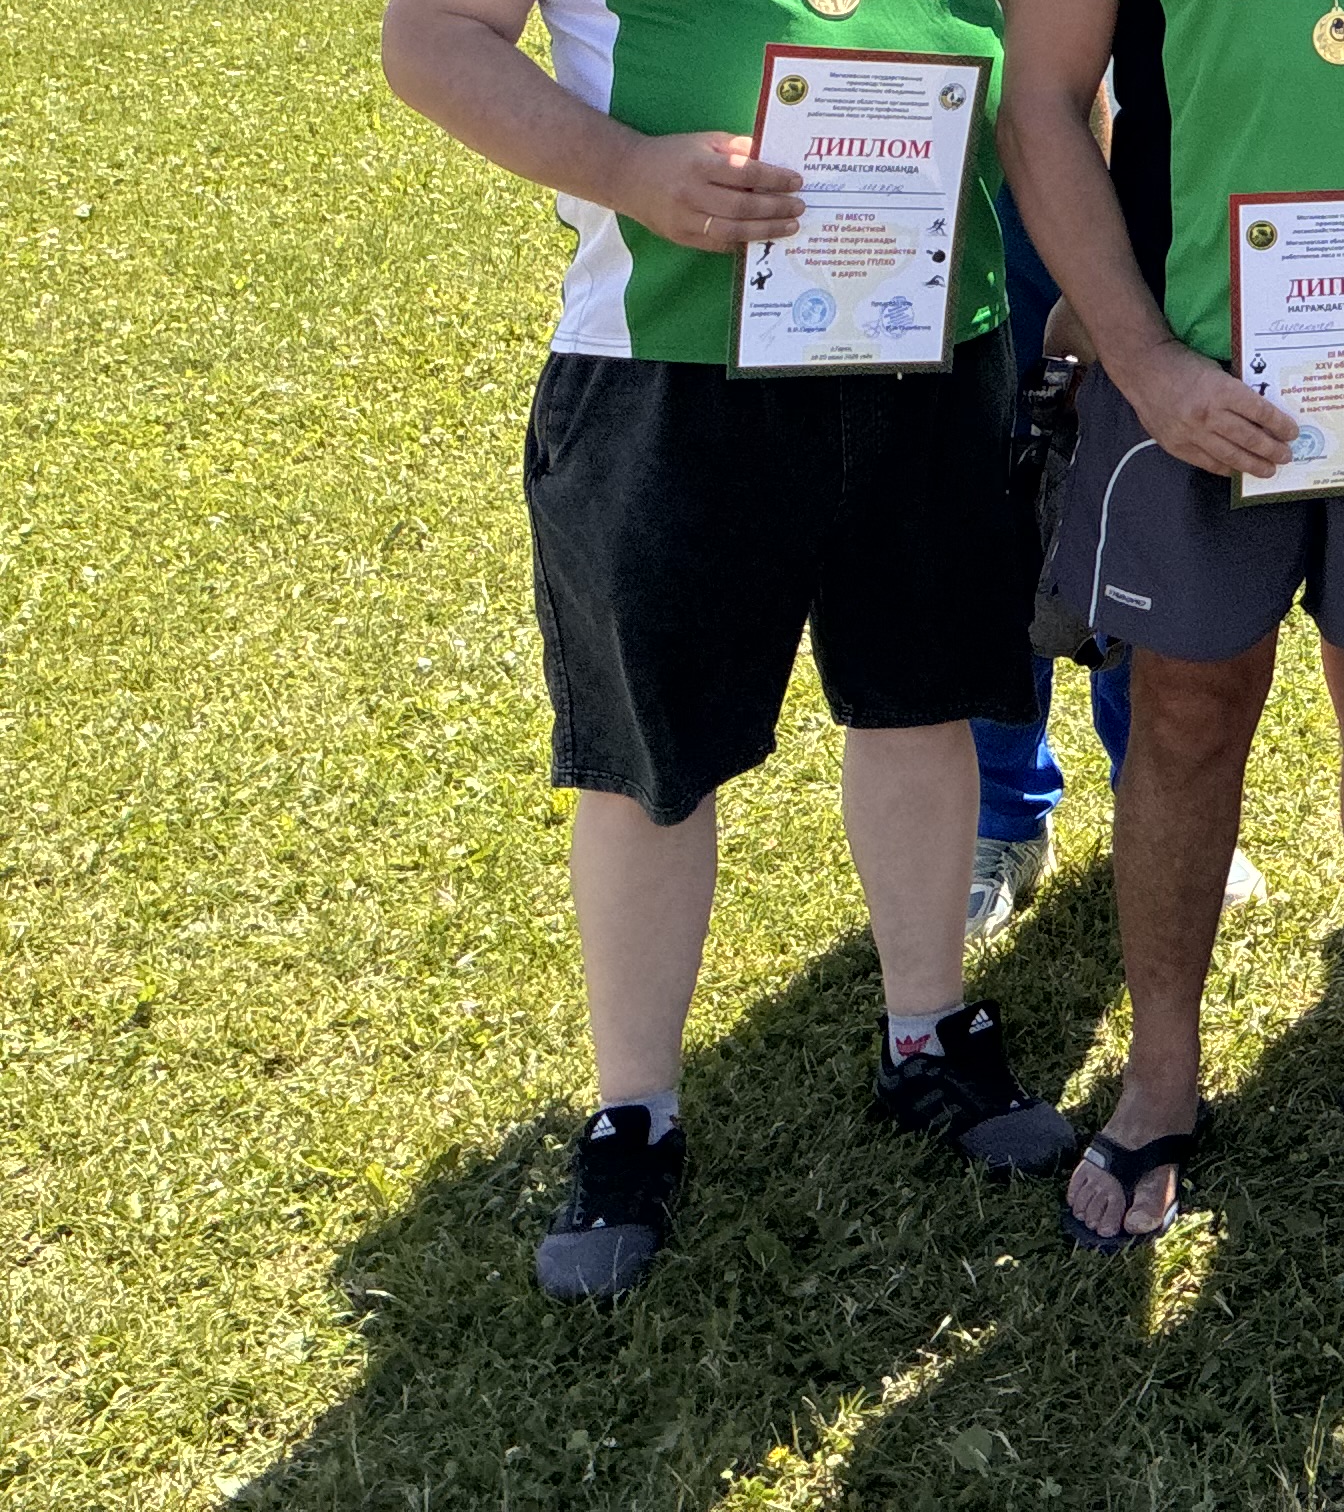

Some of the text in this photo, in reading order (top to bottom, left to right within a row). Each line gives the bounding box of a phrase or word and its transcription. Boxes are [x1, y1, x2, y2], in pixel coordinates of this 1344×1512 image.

[804, 137, 933, 161] ДИПЛОМ
[804, 163, 919, 174] НАГРАЖДАЕТСЯ КОМАНДА
[822, 224, 886, 233] XXV областной
[1315, 362, 1333, 370] XXV
